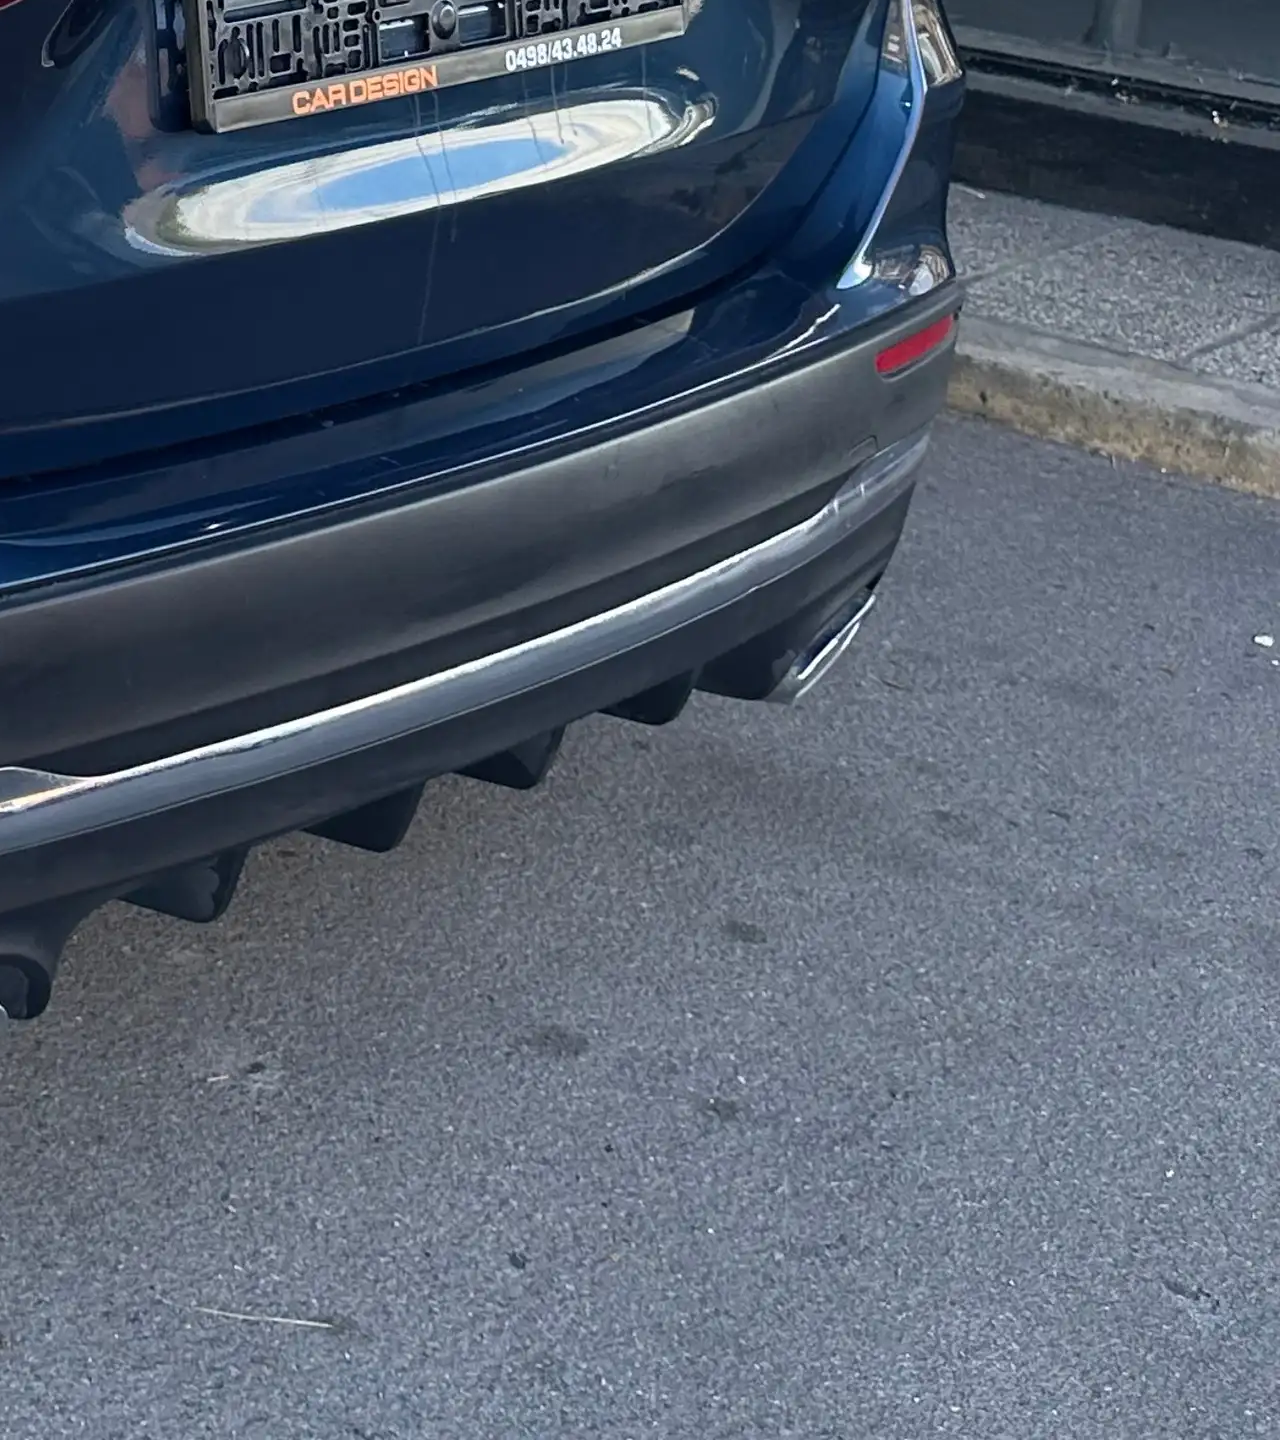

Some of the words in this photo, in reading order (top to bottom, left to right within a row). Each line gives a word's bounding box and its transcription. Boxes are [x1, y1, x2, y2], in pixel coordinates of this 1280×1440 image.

[504, 26, 623, 72] 0498/43.48.24
[291, 83, 346, 115] CAR
[348, 65, 438, 103] DESIGN
